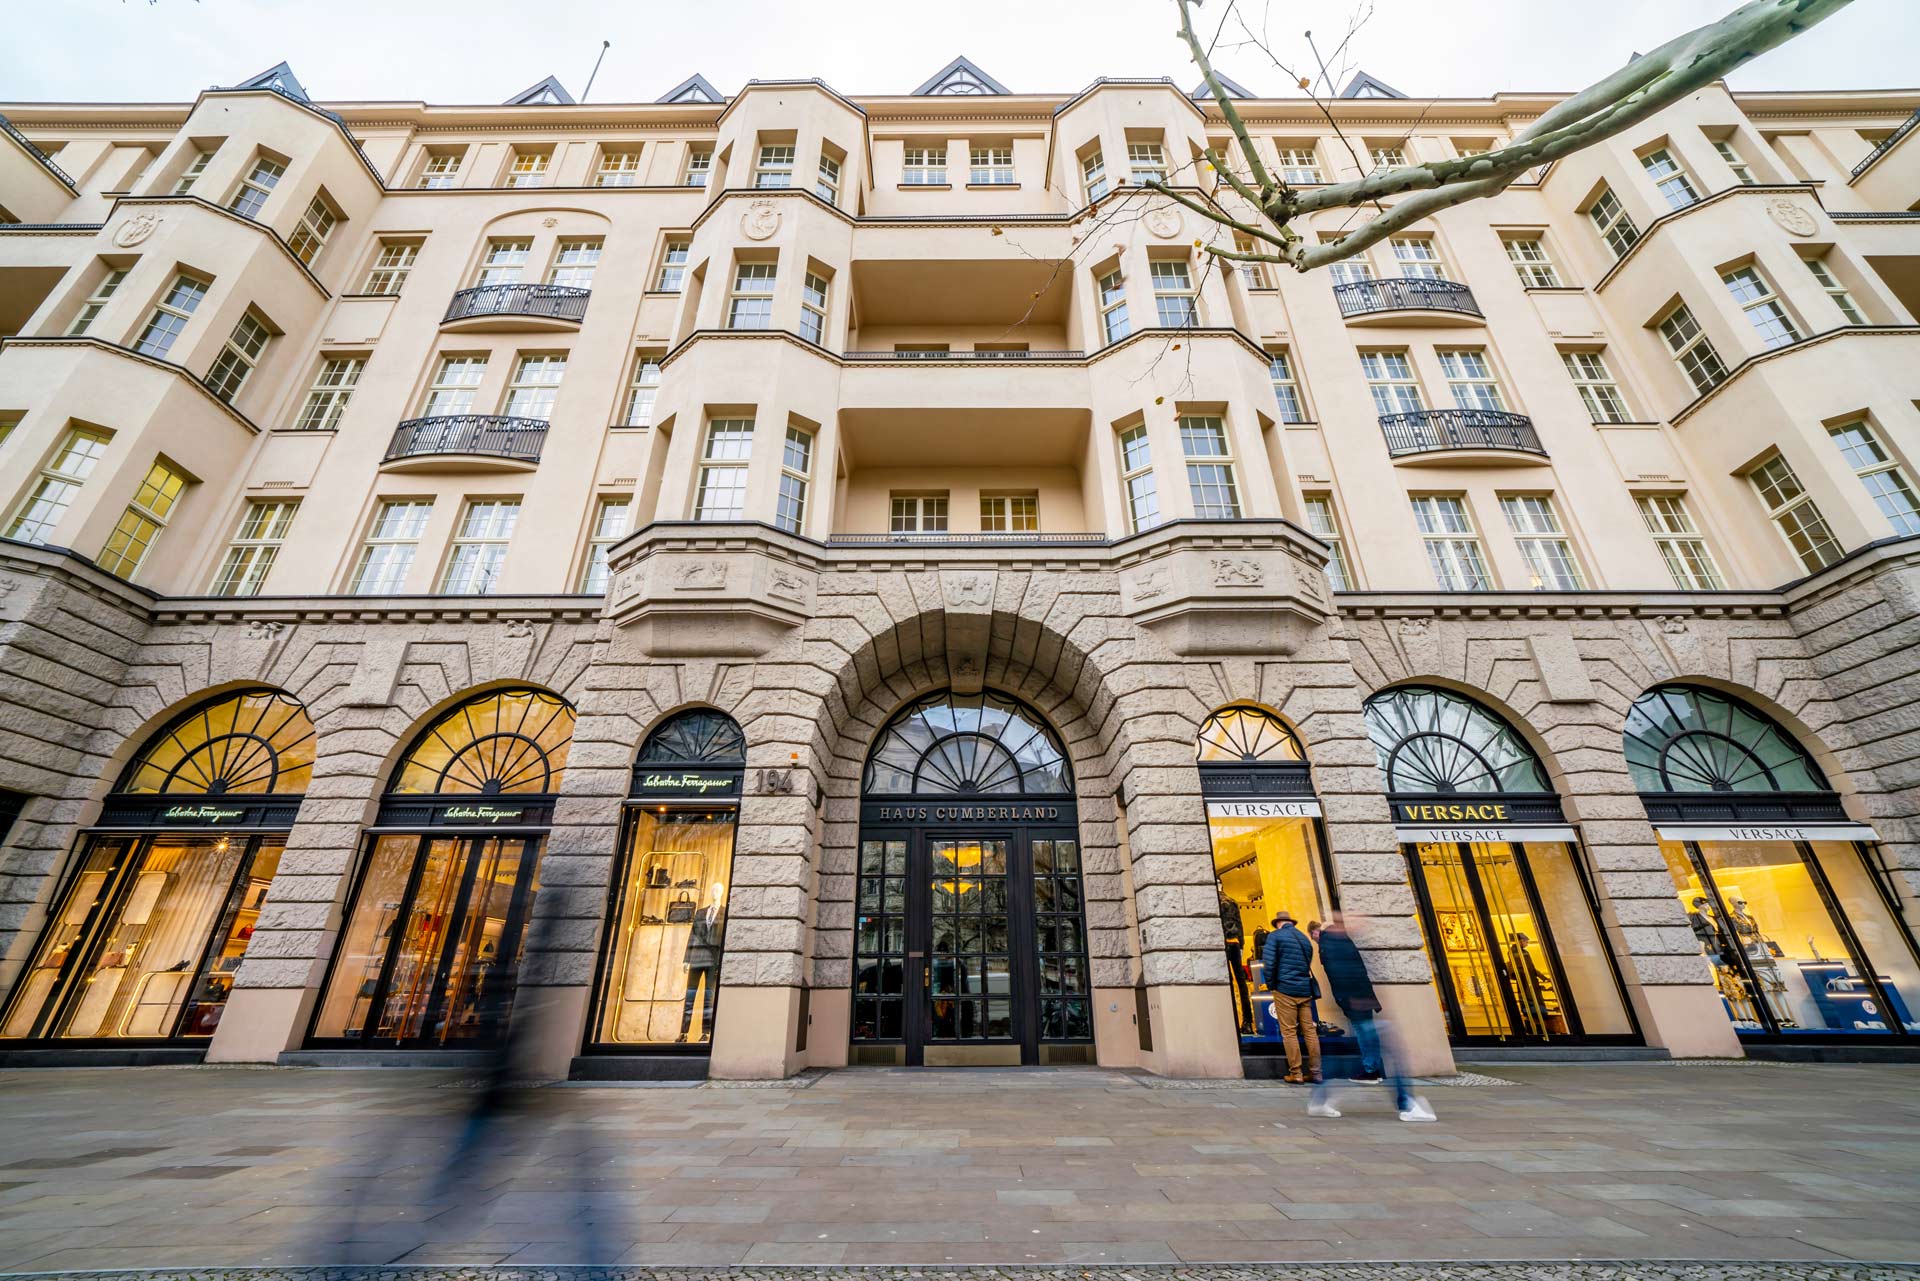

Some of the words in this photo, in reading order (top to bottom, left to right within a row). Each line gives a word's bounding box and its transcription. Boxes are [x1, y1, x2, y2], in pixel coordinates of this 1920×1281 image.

[643, 775, 681, 787] Salvatore
[681, 774, 732, 793] Ferragamo
[755, 769, 793, 793] 194
[198, 806, 243, 823] Ferragamo
[477, 806, 521, 823] Ferragamo
[880, 807, 927, 820] HAUS
[936, 807, 1058, 820] CUMBERLAND
[1220, 804, 1310, 816] VERSACE
[1405, 805, 1508, 820] VERSACE
[1430, 830, 1507, 841] VERSACE
[1729, 828, 1808, 840] VERSACE
